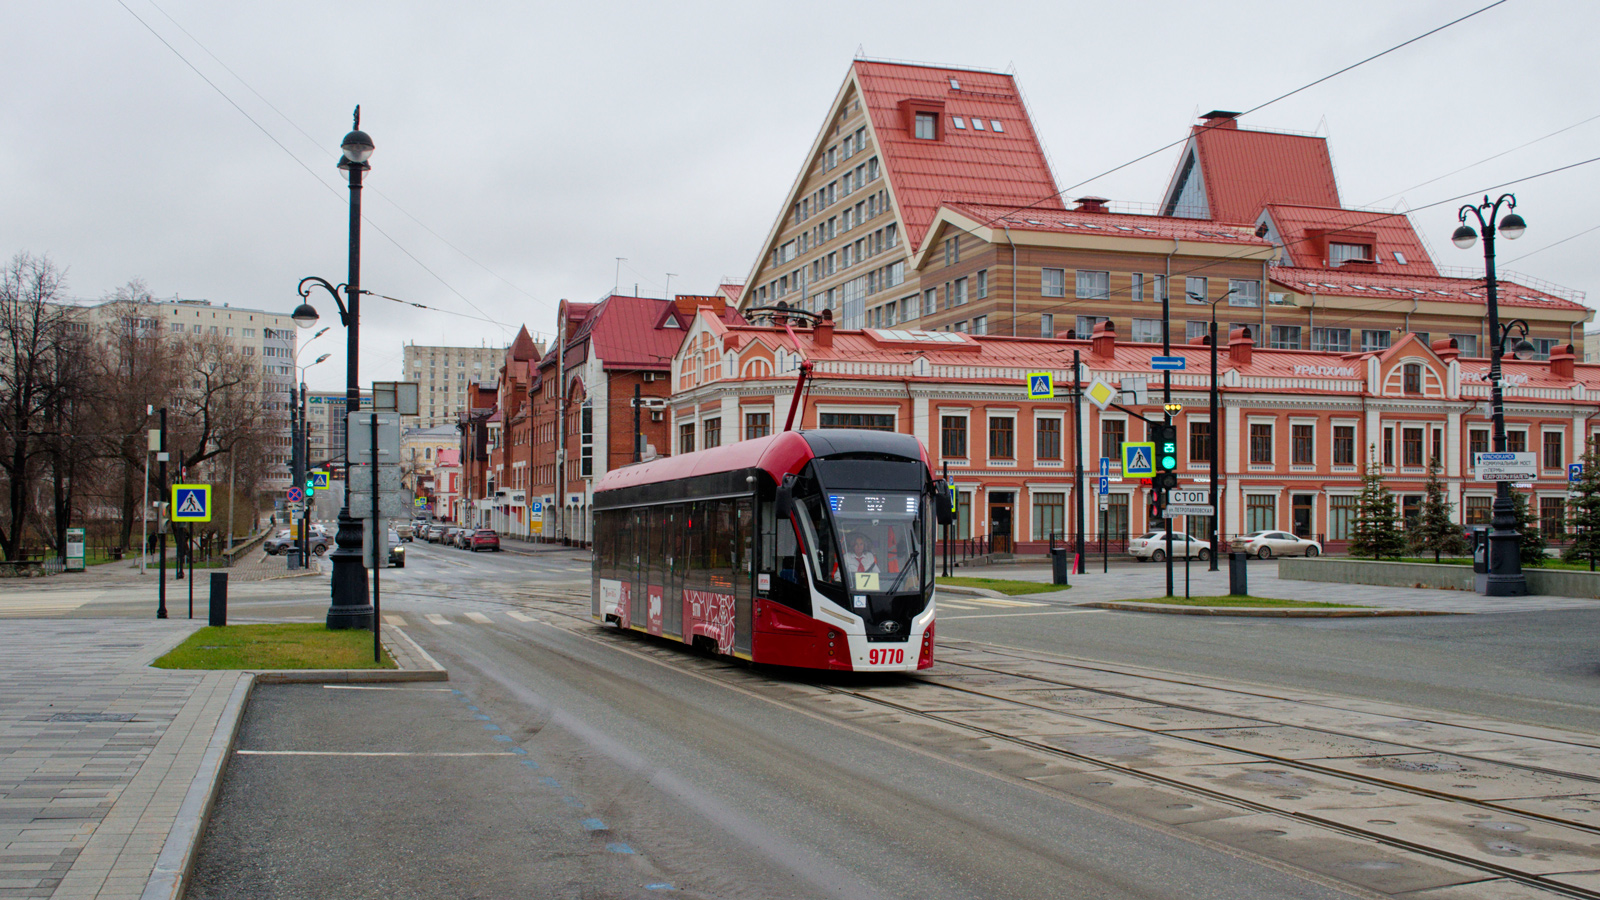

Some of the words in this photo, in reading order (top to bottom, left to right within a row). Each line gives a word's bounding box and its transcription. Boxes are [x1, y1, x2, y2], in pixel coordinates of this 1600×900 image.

[1293, 365, 1354, 377] УРАЛХИМ
[1460, 372, 1528, 384] УРАЛЛИЙ
[1174, 492, 1204, 502] СТОП
[861, 575, 871, 588] 7
[869, 649, 904, 664] 9770
